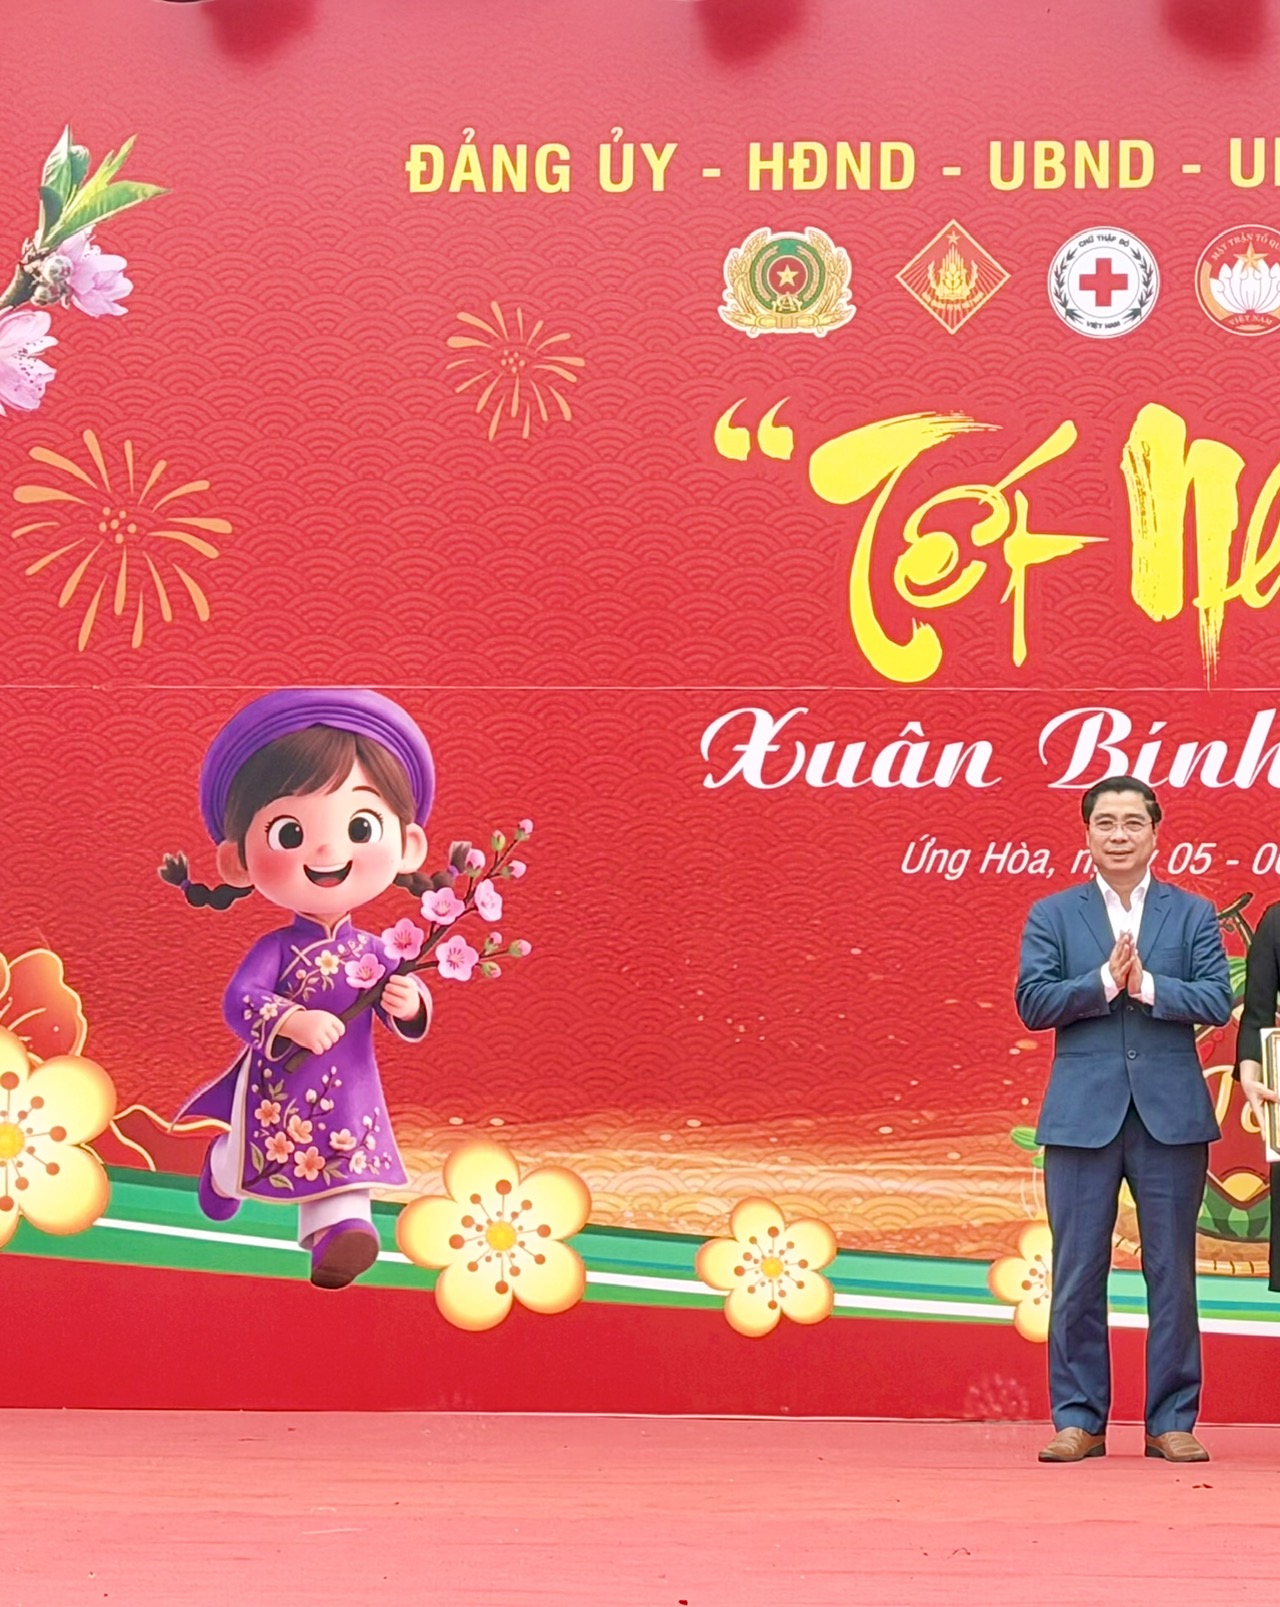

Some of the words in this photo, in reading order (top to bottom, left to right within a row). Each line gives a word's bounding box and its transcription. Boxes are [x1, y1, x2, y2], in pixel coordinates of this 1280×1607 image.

[405, 127, 571, 194] ĐẢNG
[599, 126, 678, 193] ỦY
[702, 168, 721, 178] -
[748, 141, 915, 191] HĐND
[942, 166, 961, 176] -
[989, 139, 1155, 191] UBND
[1182, 164, 1201, 174] -
[700, 706, 1003, 789] Xuân
[901, 834, 971, 881] Ứng
[979, 842, 1055, 878] Hòa,
[1167, 842, 1217, 875] 05
